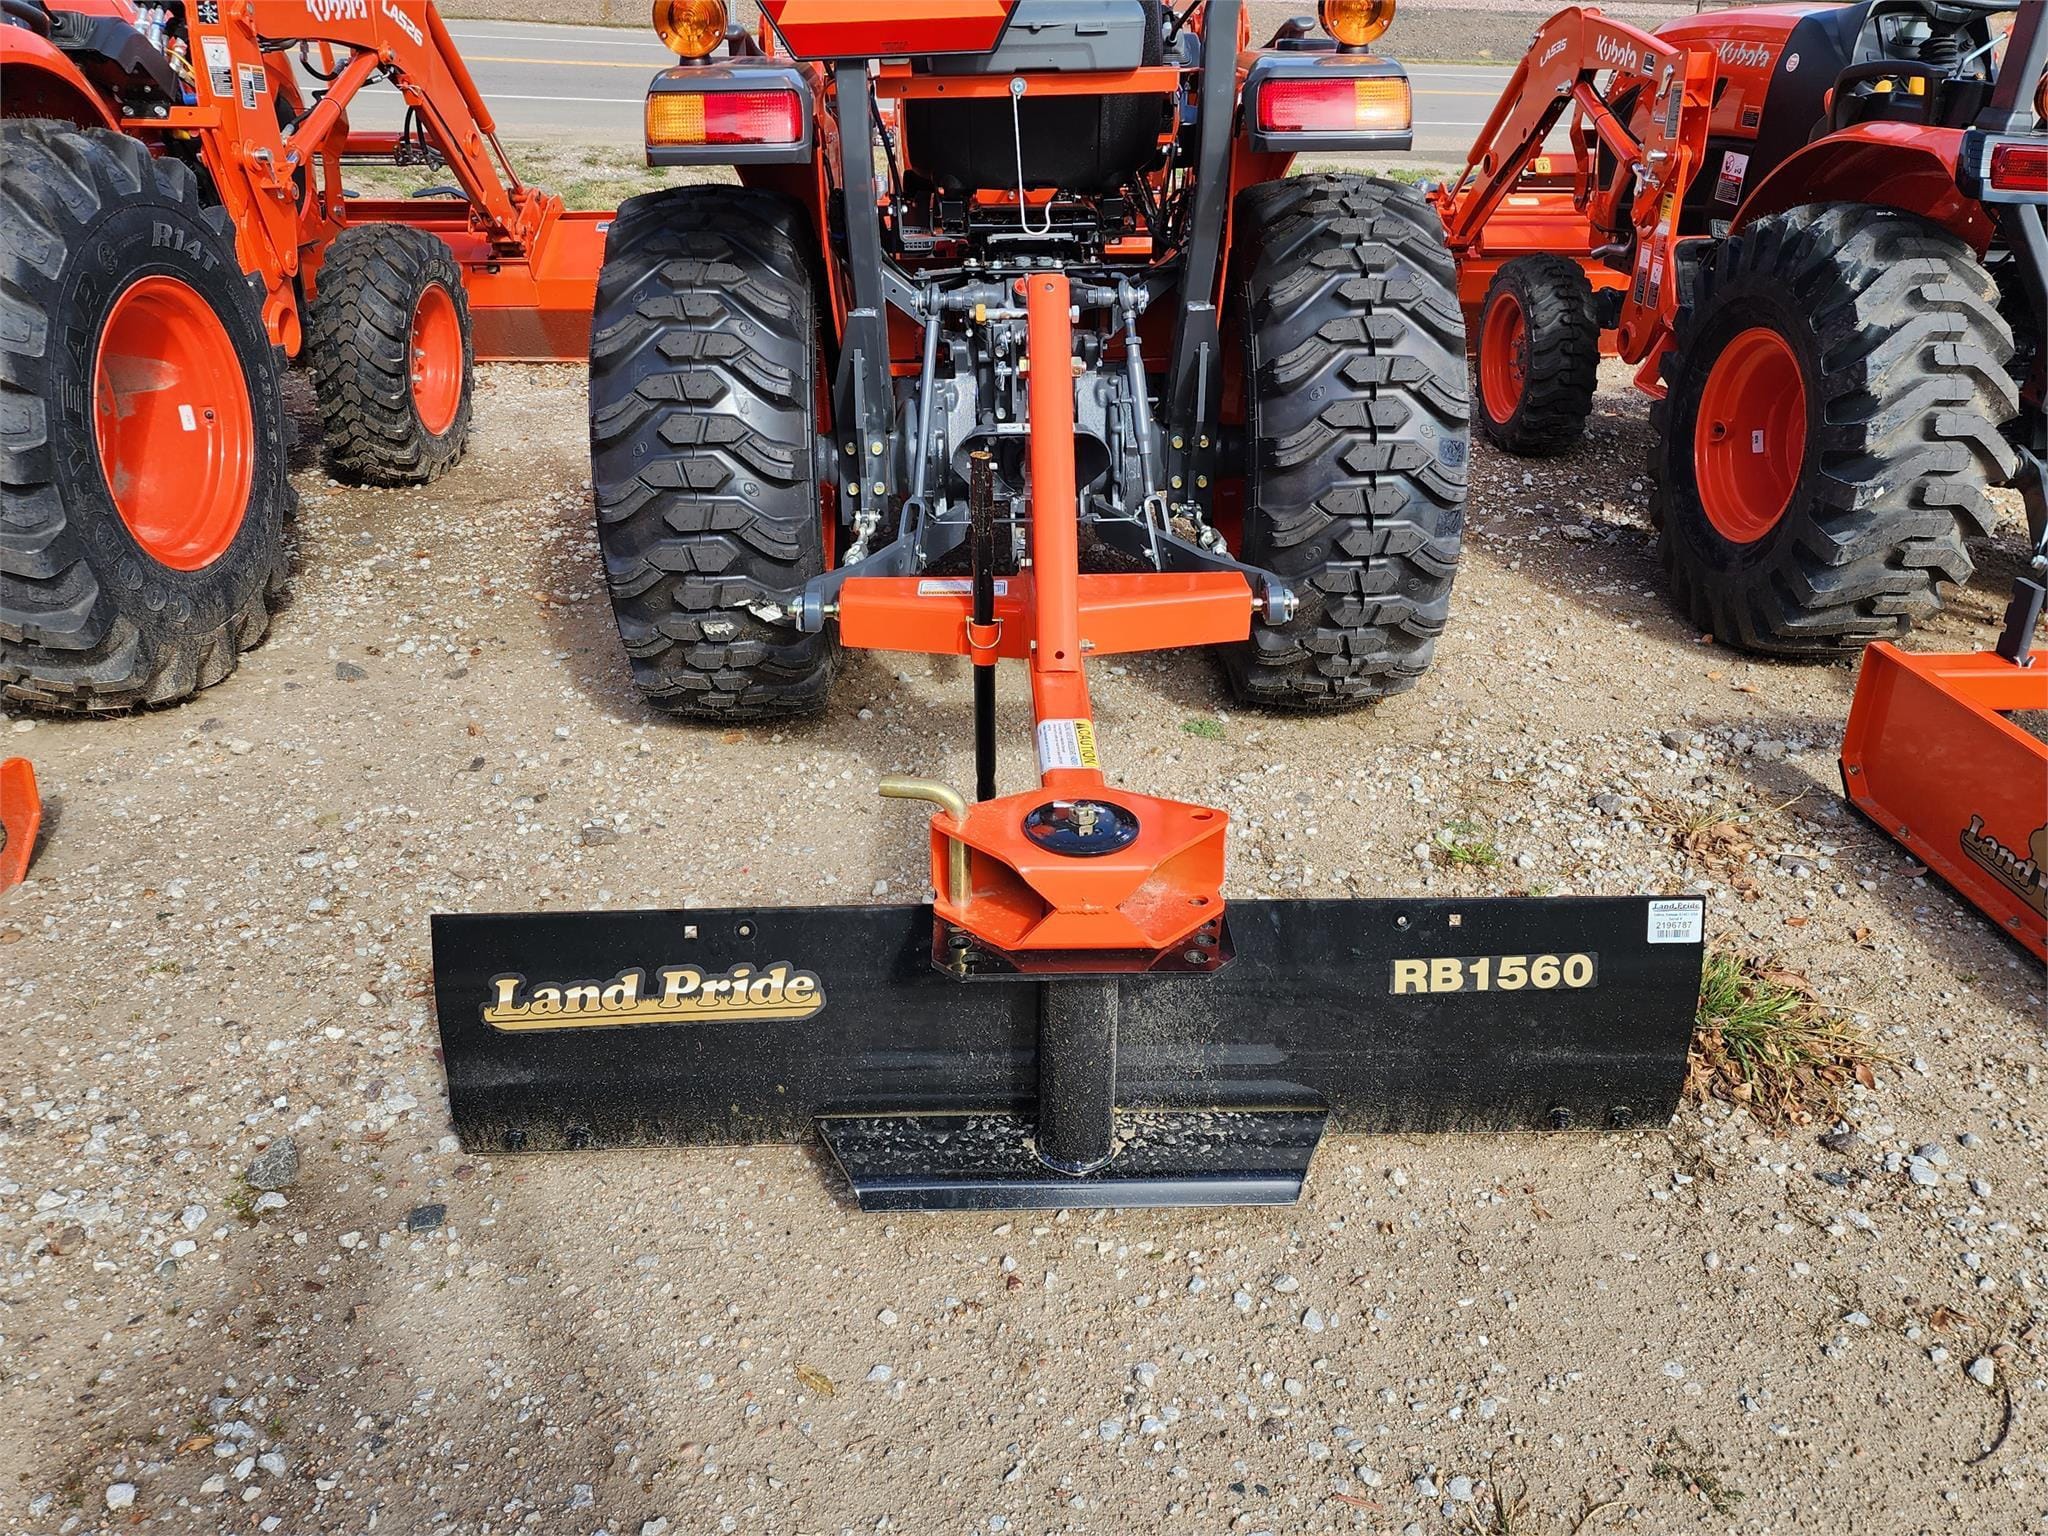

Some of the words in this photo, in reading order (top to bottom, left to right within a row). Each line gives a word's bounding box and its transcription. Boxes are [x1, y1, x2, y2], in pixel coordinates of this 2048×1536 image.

[381, 0, 424, 47] LA526
[1540, 38, 1568, 67] LA535
[1596, 34, 1637, 69] Kubota
[1718, 41, 1770, 68] Kubota
[152, 221, 219, 271] R14T
[1077, 727, 1098, 768] CAUTION
[1964, 815, 2038, 887] Land
[1656, 921, 1692, 929] 2196787
[492, 974, 639, 1016] Land
[658, 967, 815, 1009] Pride
[1394, 954, 1594, 994] RB1560
